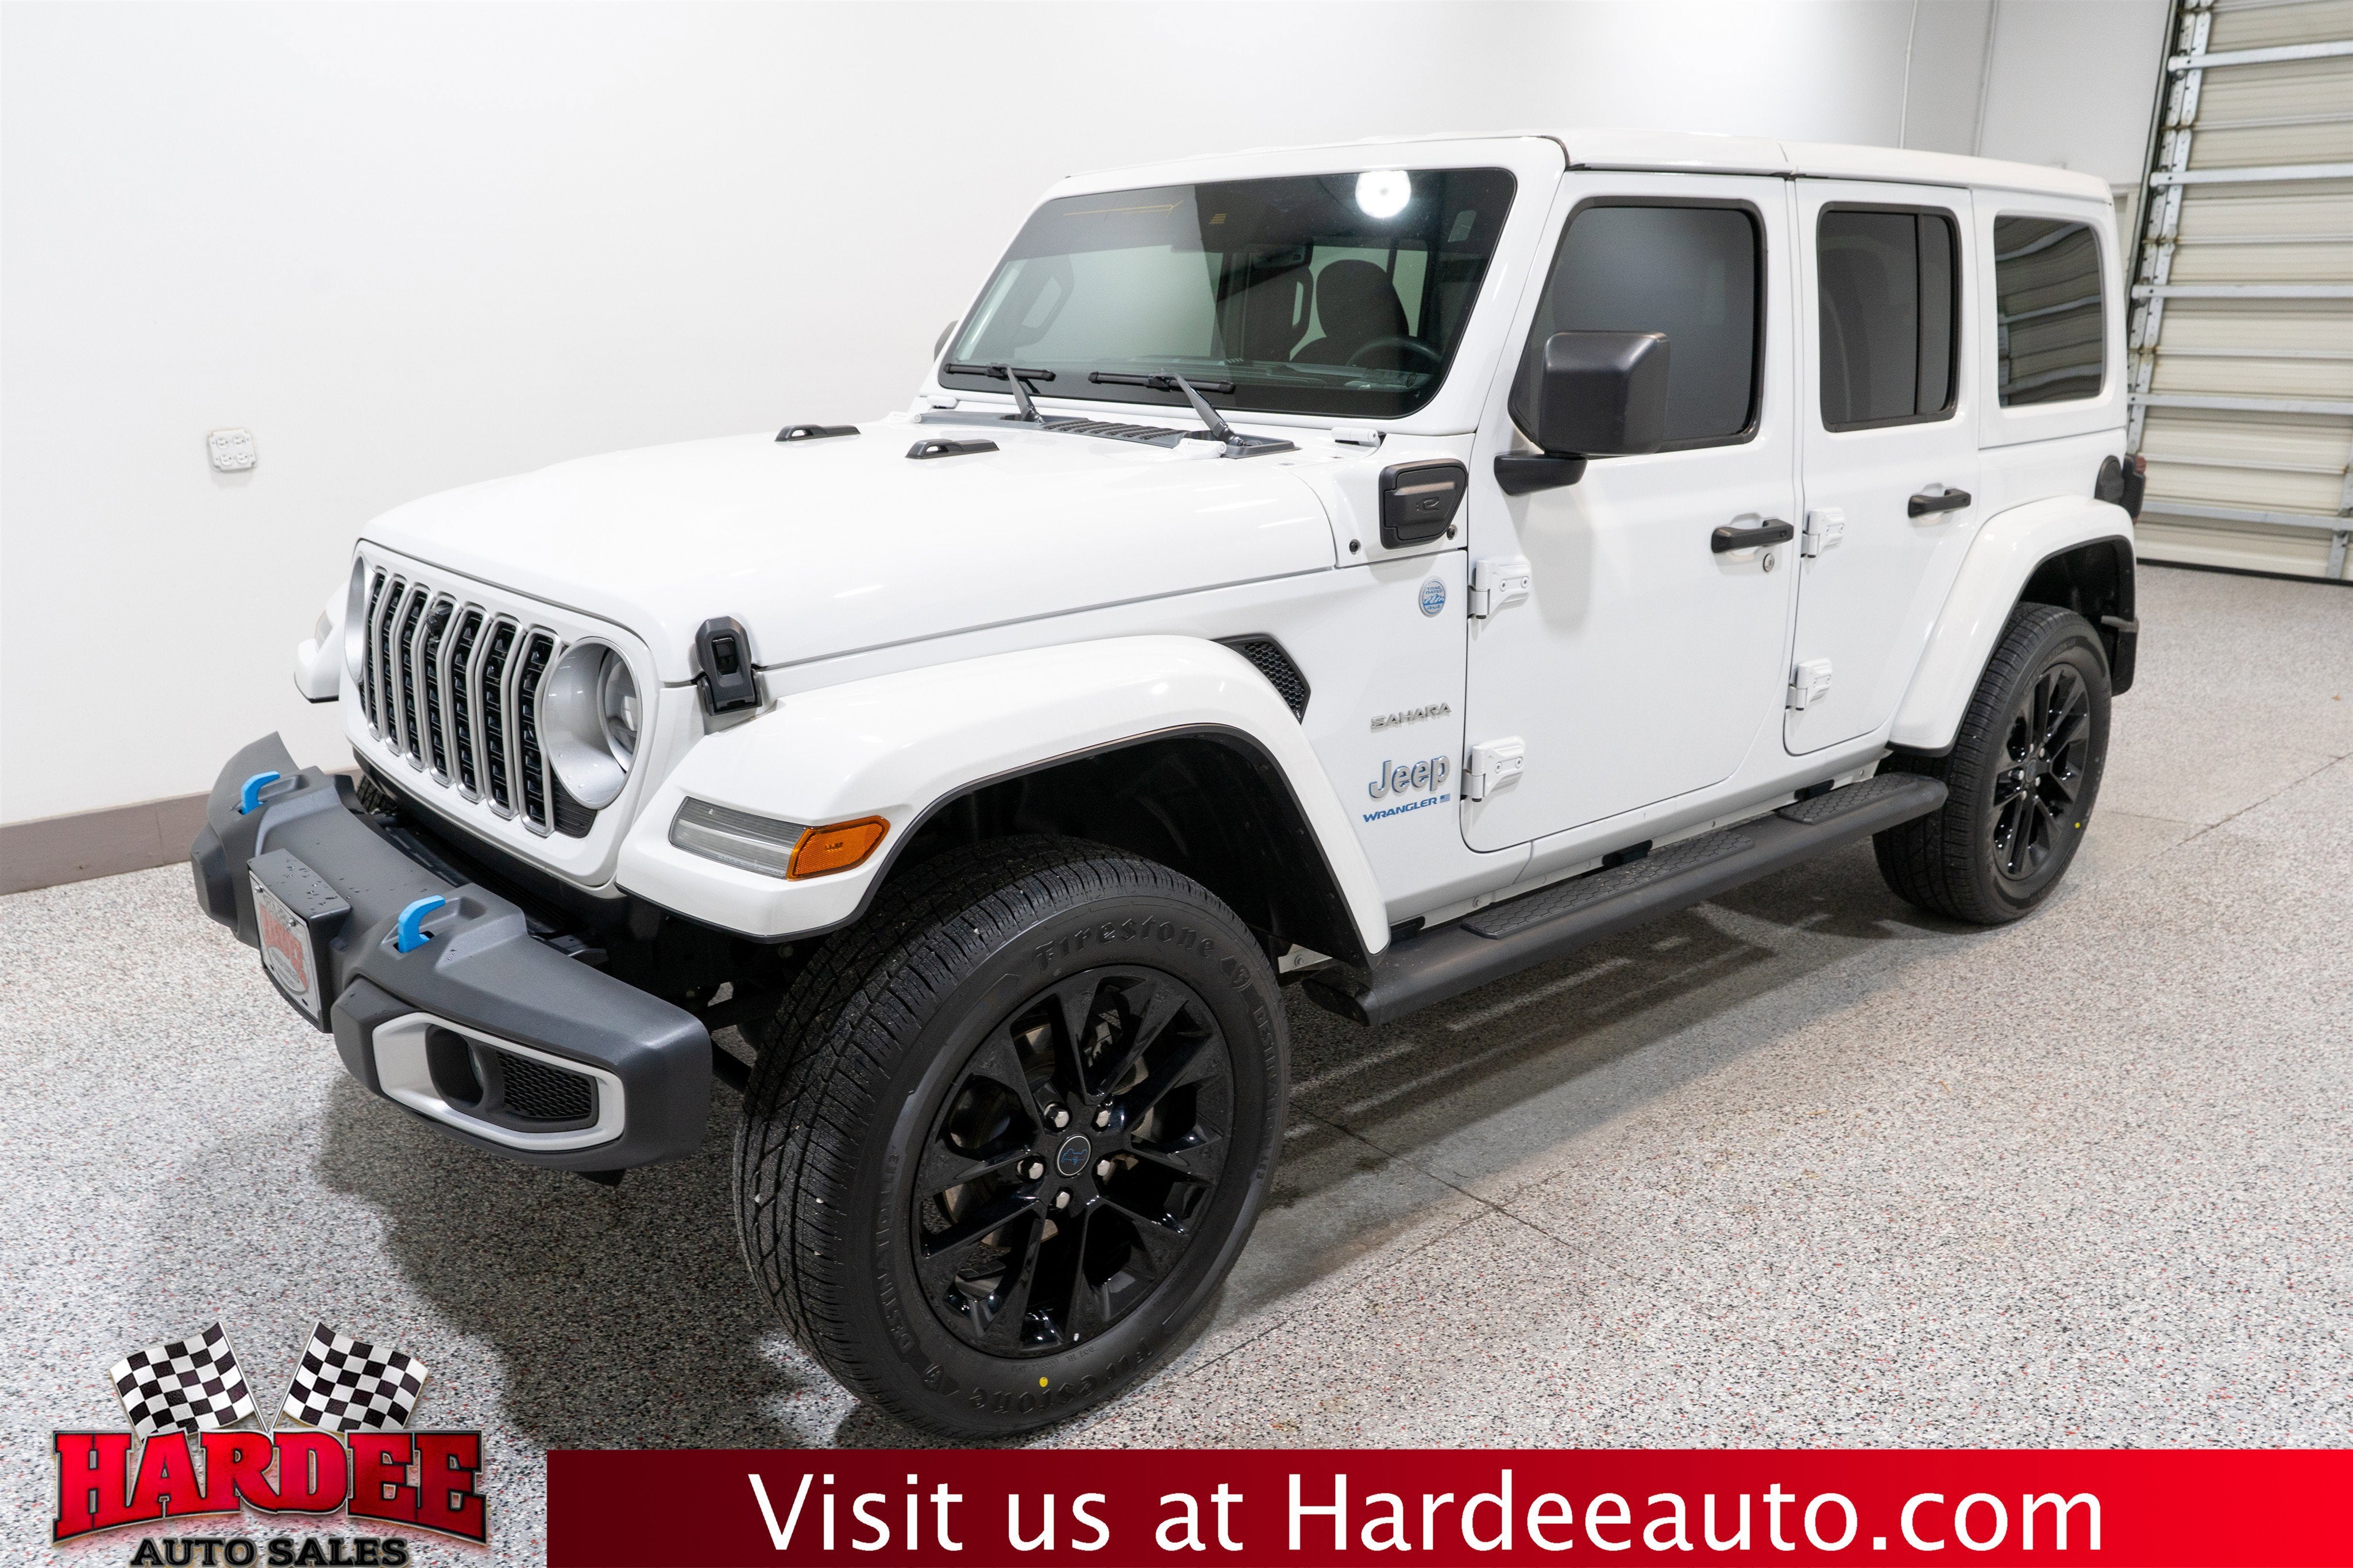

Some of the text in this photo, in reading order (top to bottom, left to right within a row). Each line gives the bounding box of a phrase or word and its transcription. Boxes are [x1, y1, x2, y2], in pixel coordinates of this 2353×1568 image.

[1371, 702, 1452, 728] SAHARA
[1369, 755, 1451, 798] Jeep
[1363, 797, 1437, 822] WRANGLER
[1035, 915, 1215, 972] Firestone
